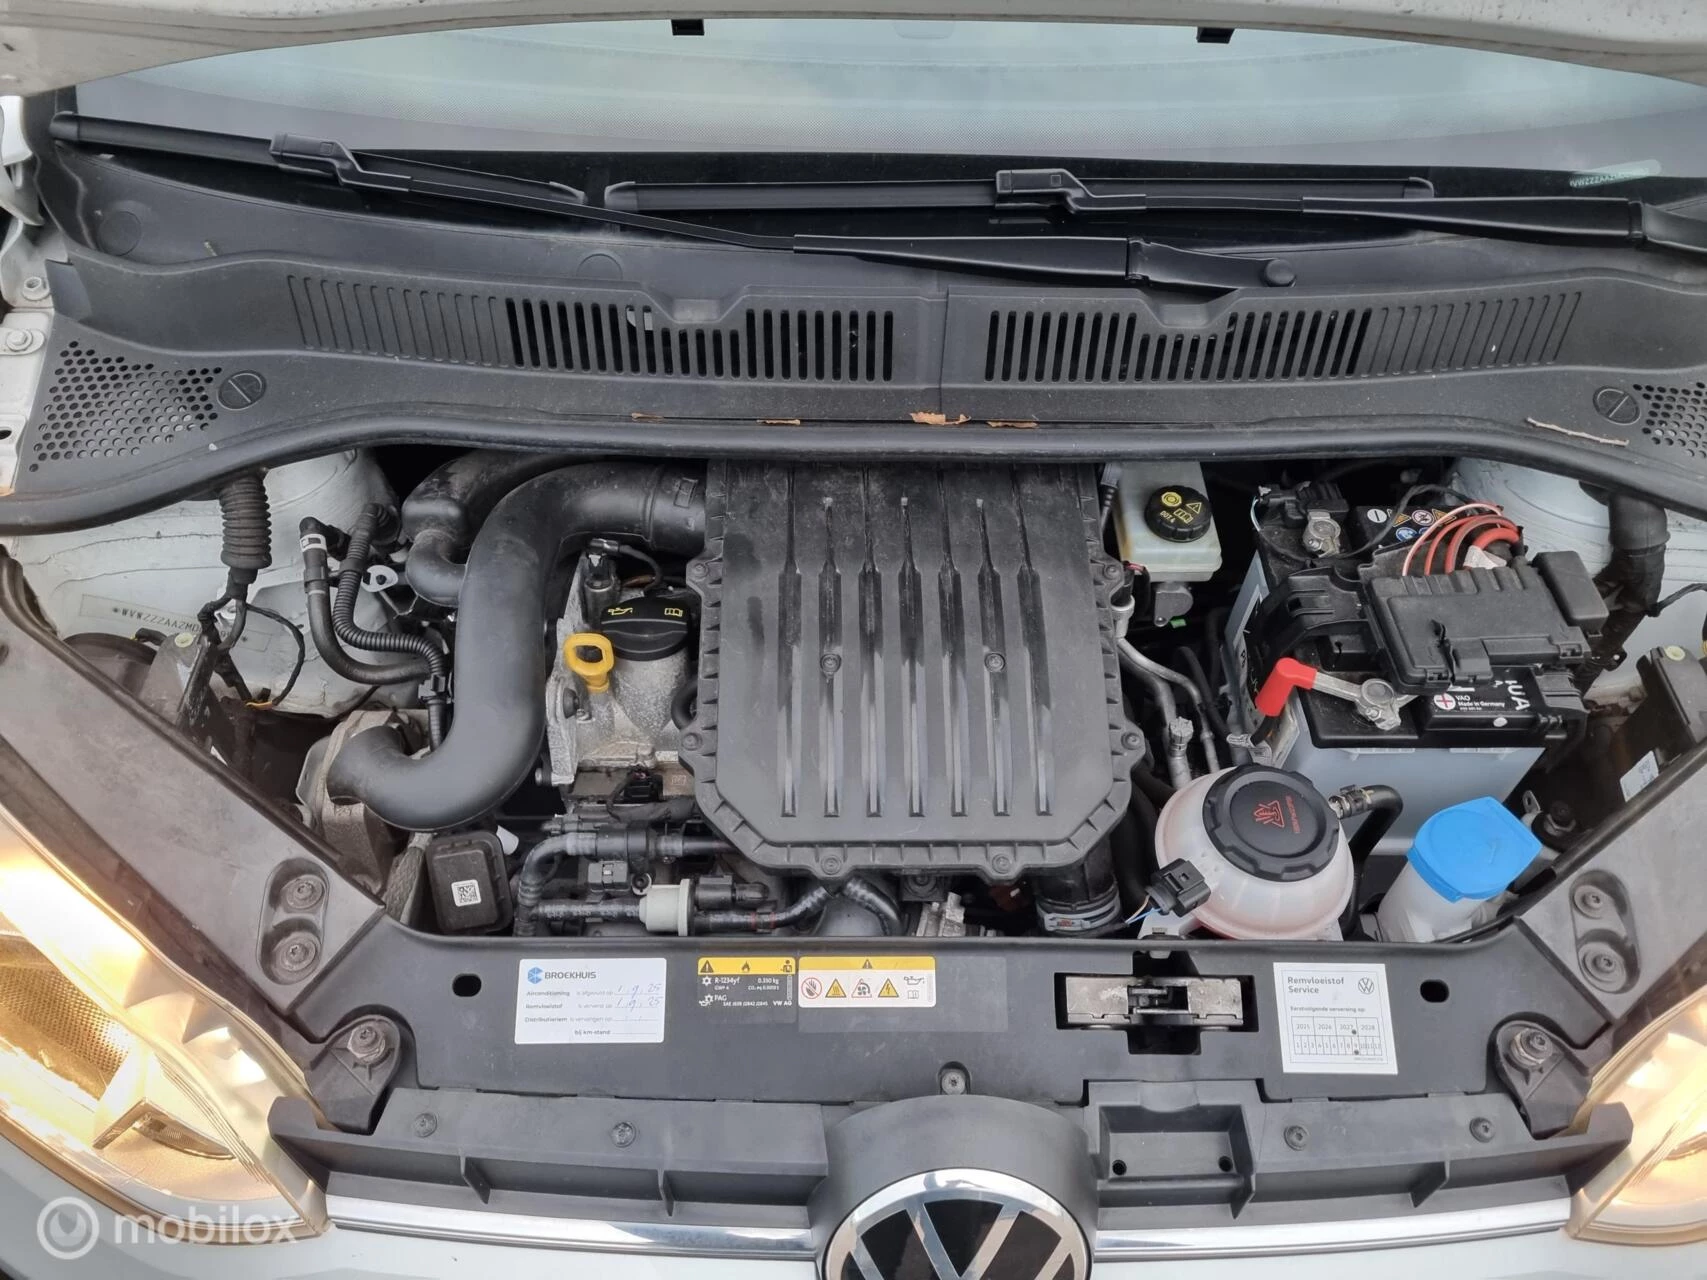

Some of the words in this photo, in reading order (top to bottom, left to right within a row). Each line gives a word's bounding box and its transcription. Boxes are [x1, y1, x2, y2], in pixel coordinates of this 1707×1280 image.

[544, 971, 597, 979] BROEKHUIS
[1287, 976, 1345, 985] Remvloeistof
[1288, 986, 1319, 994] Service
